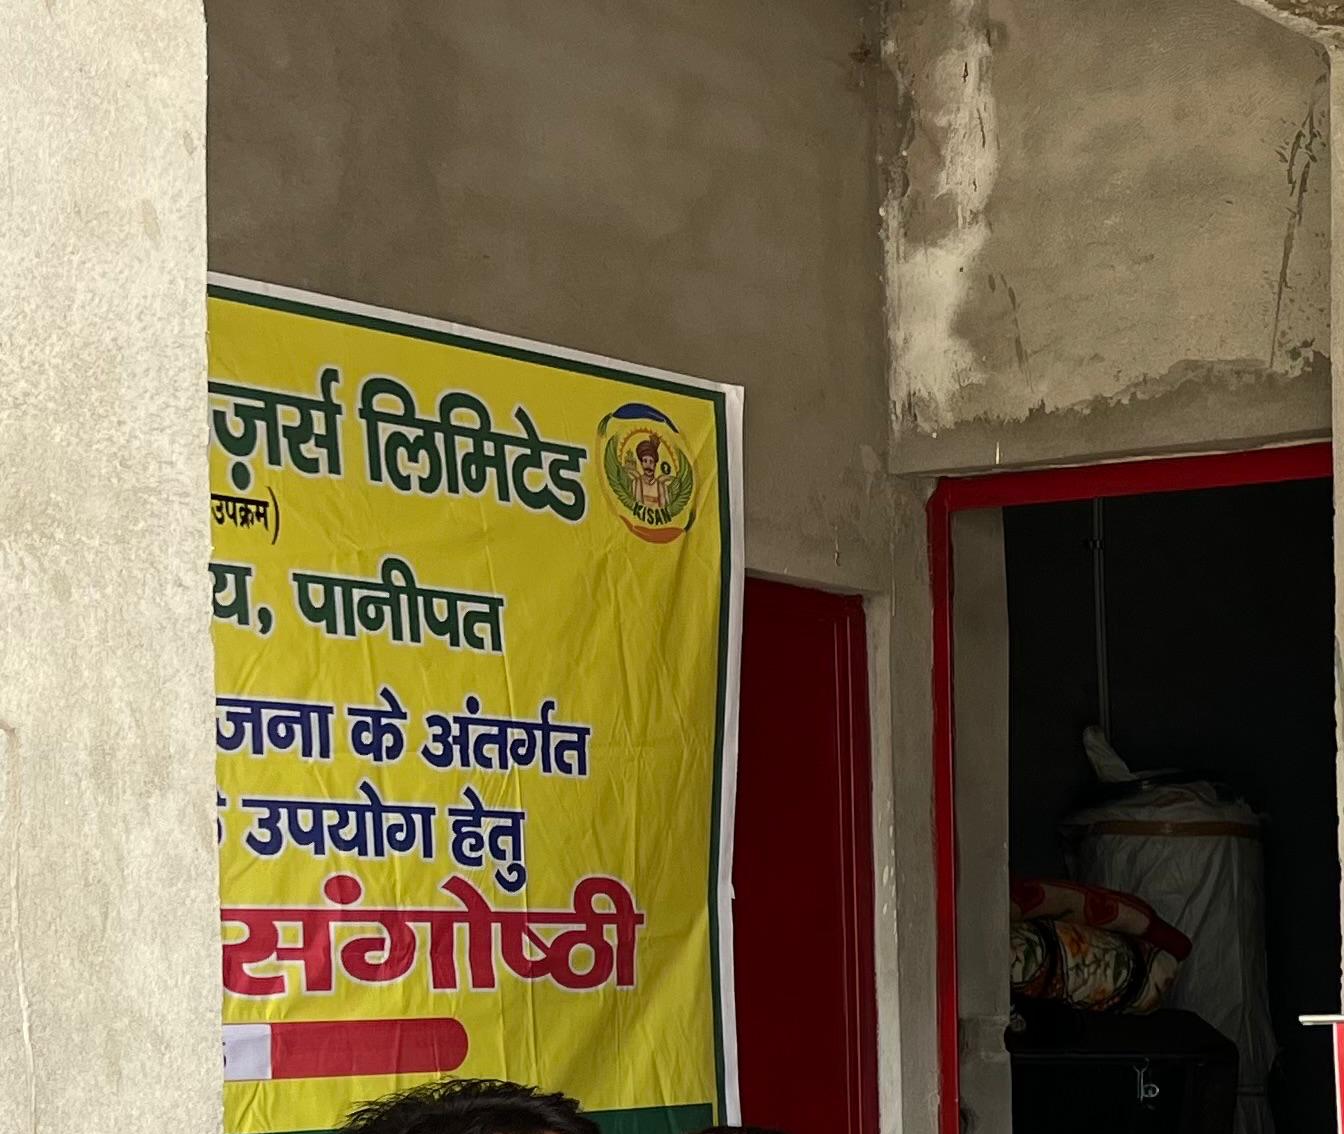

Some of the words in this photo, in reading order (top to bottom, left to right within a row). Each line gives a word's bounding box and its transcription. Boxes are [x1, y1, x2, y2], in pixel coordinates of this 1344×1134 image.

[208, 368, 344, 490] ज़र्स
[358, 377, 588, 522] लिमिटेड
[633, 502, 672, 525] KISAN
[209, 563, 274, 637] य,
[293, 557, 503, 652] पानीपत
[216, 697, 332, 759] जना
[348, 687, 407, 763] के
[422, 696, 591, 776] अंतर्गत
[242, 782, 435, 859] उपयोग
[450, 787, 525, 893] हेतु
[220, 874, 645, 995] संगोष्ठी
